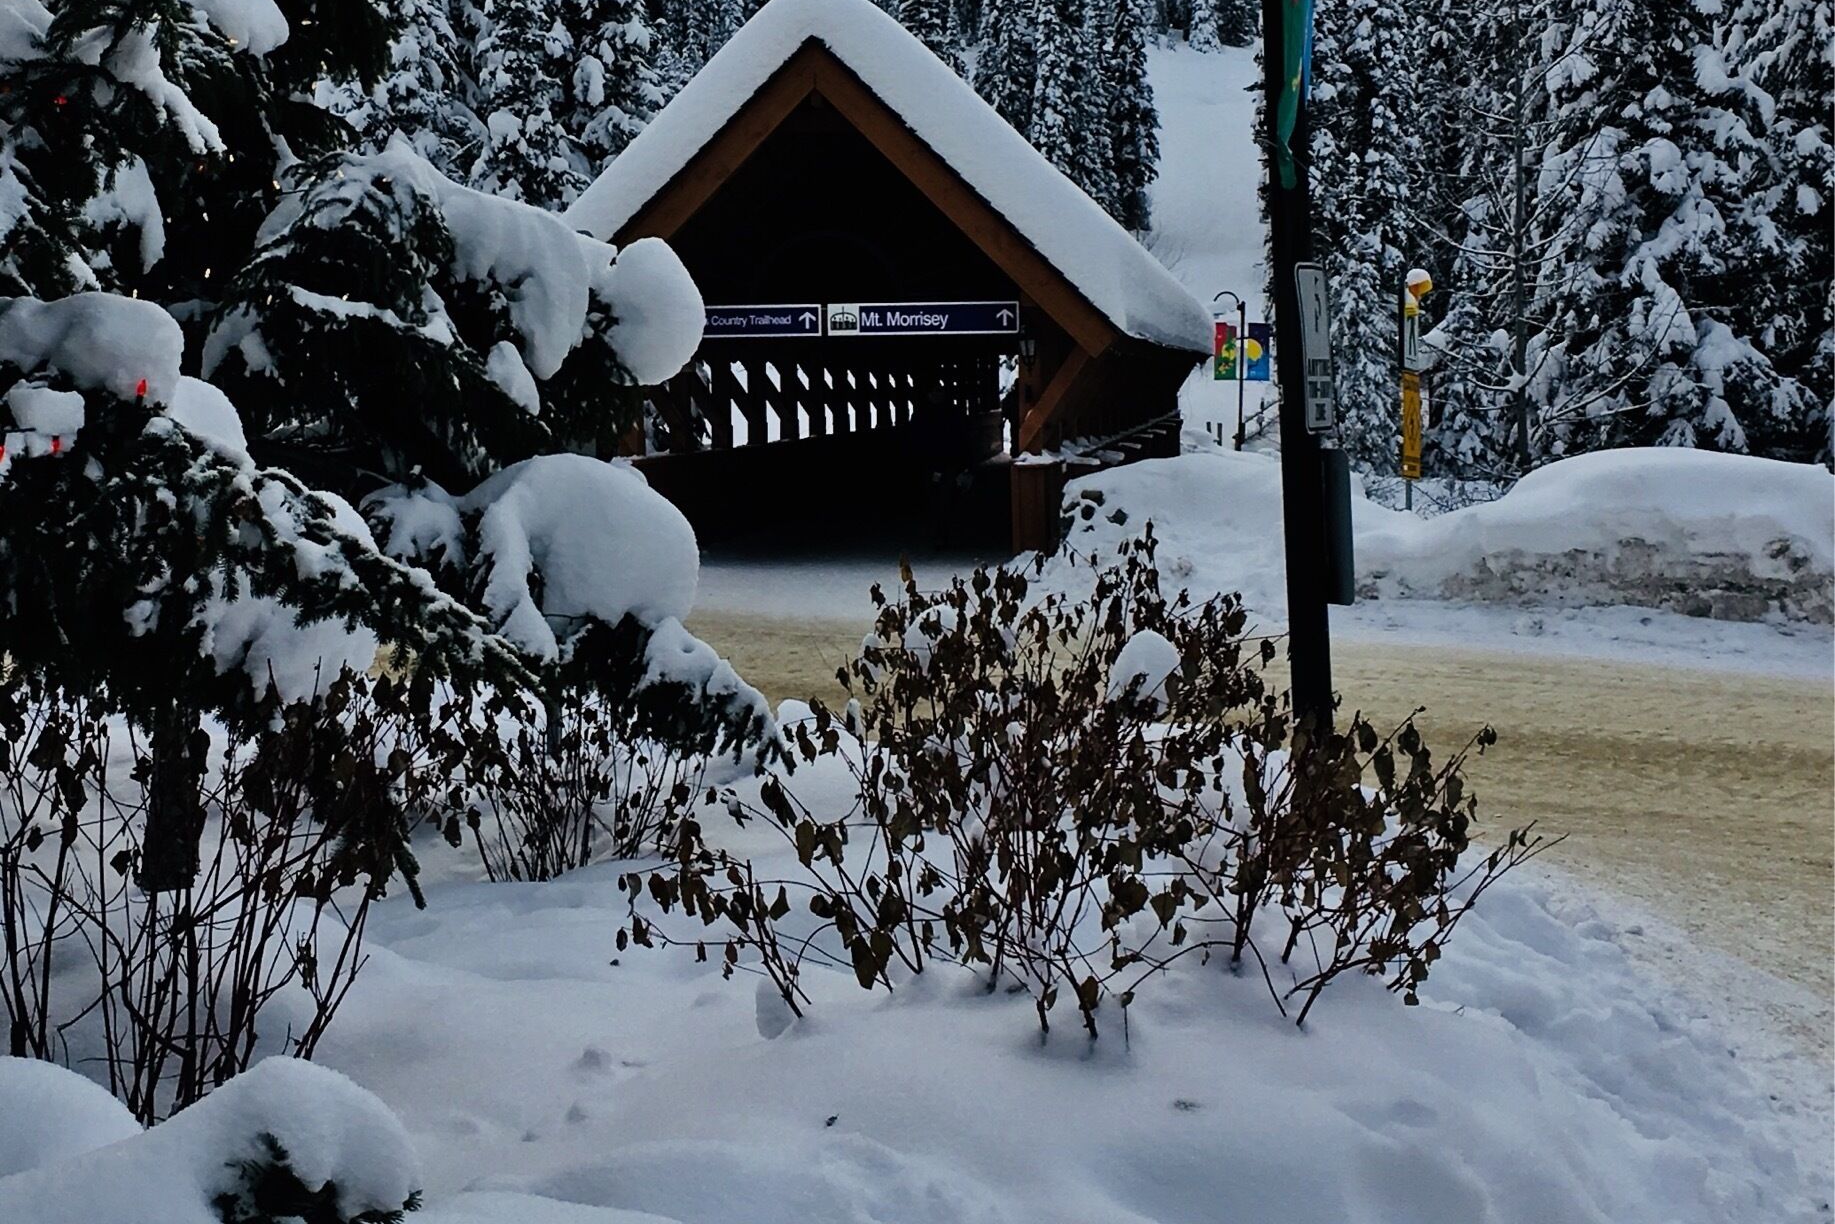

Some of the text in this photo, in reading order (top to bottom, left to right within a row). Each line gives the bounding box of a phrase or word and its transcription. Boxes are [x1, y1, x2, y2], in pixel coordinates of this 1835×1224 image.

[711, 315, 748, 328] Country
[749, 314, 792, 326] Trailhead
[861, 311, 949, 329] Mt. Morrisey
